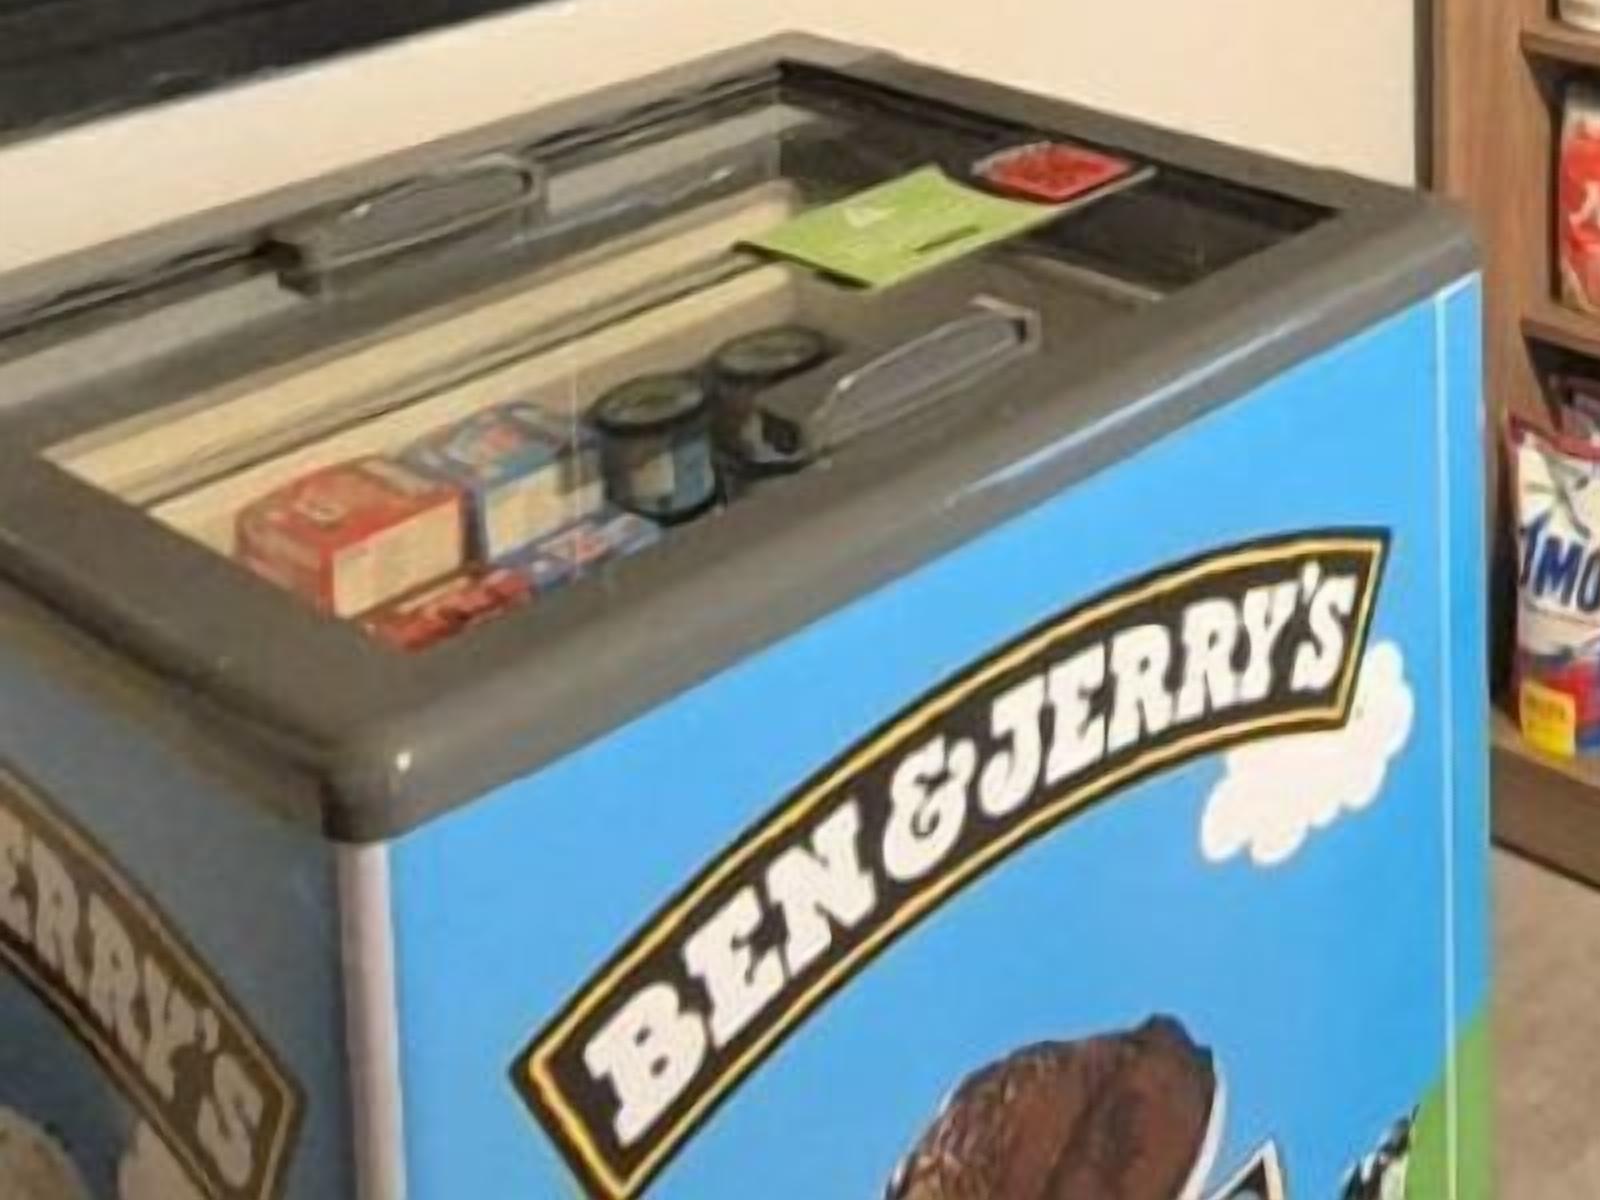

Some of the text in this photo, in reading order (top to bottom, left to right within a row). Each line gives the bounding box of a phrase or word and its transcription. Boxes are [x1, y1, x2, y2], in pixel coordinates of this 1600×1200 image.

[584, 562, 1358, 1145] BEN & JERRY'S
